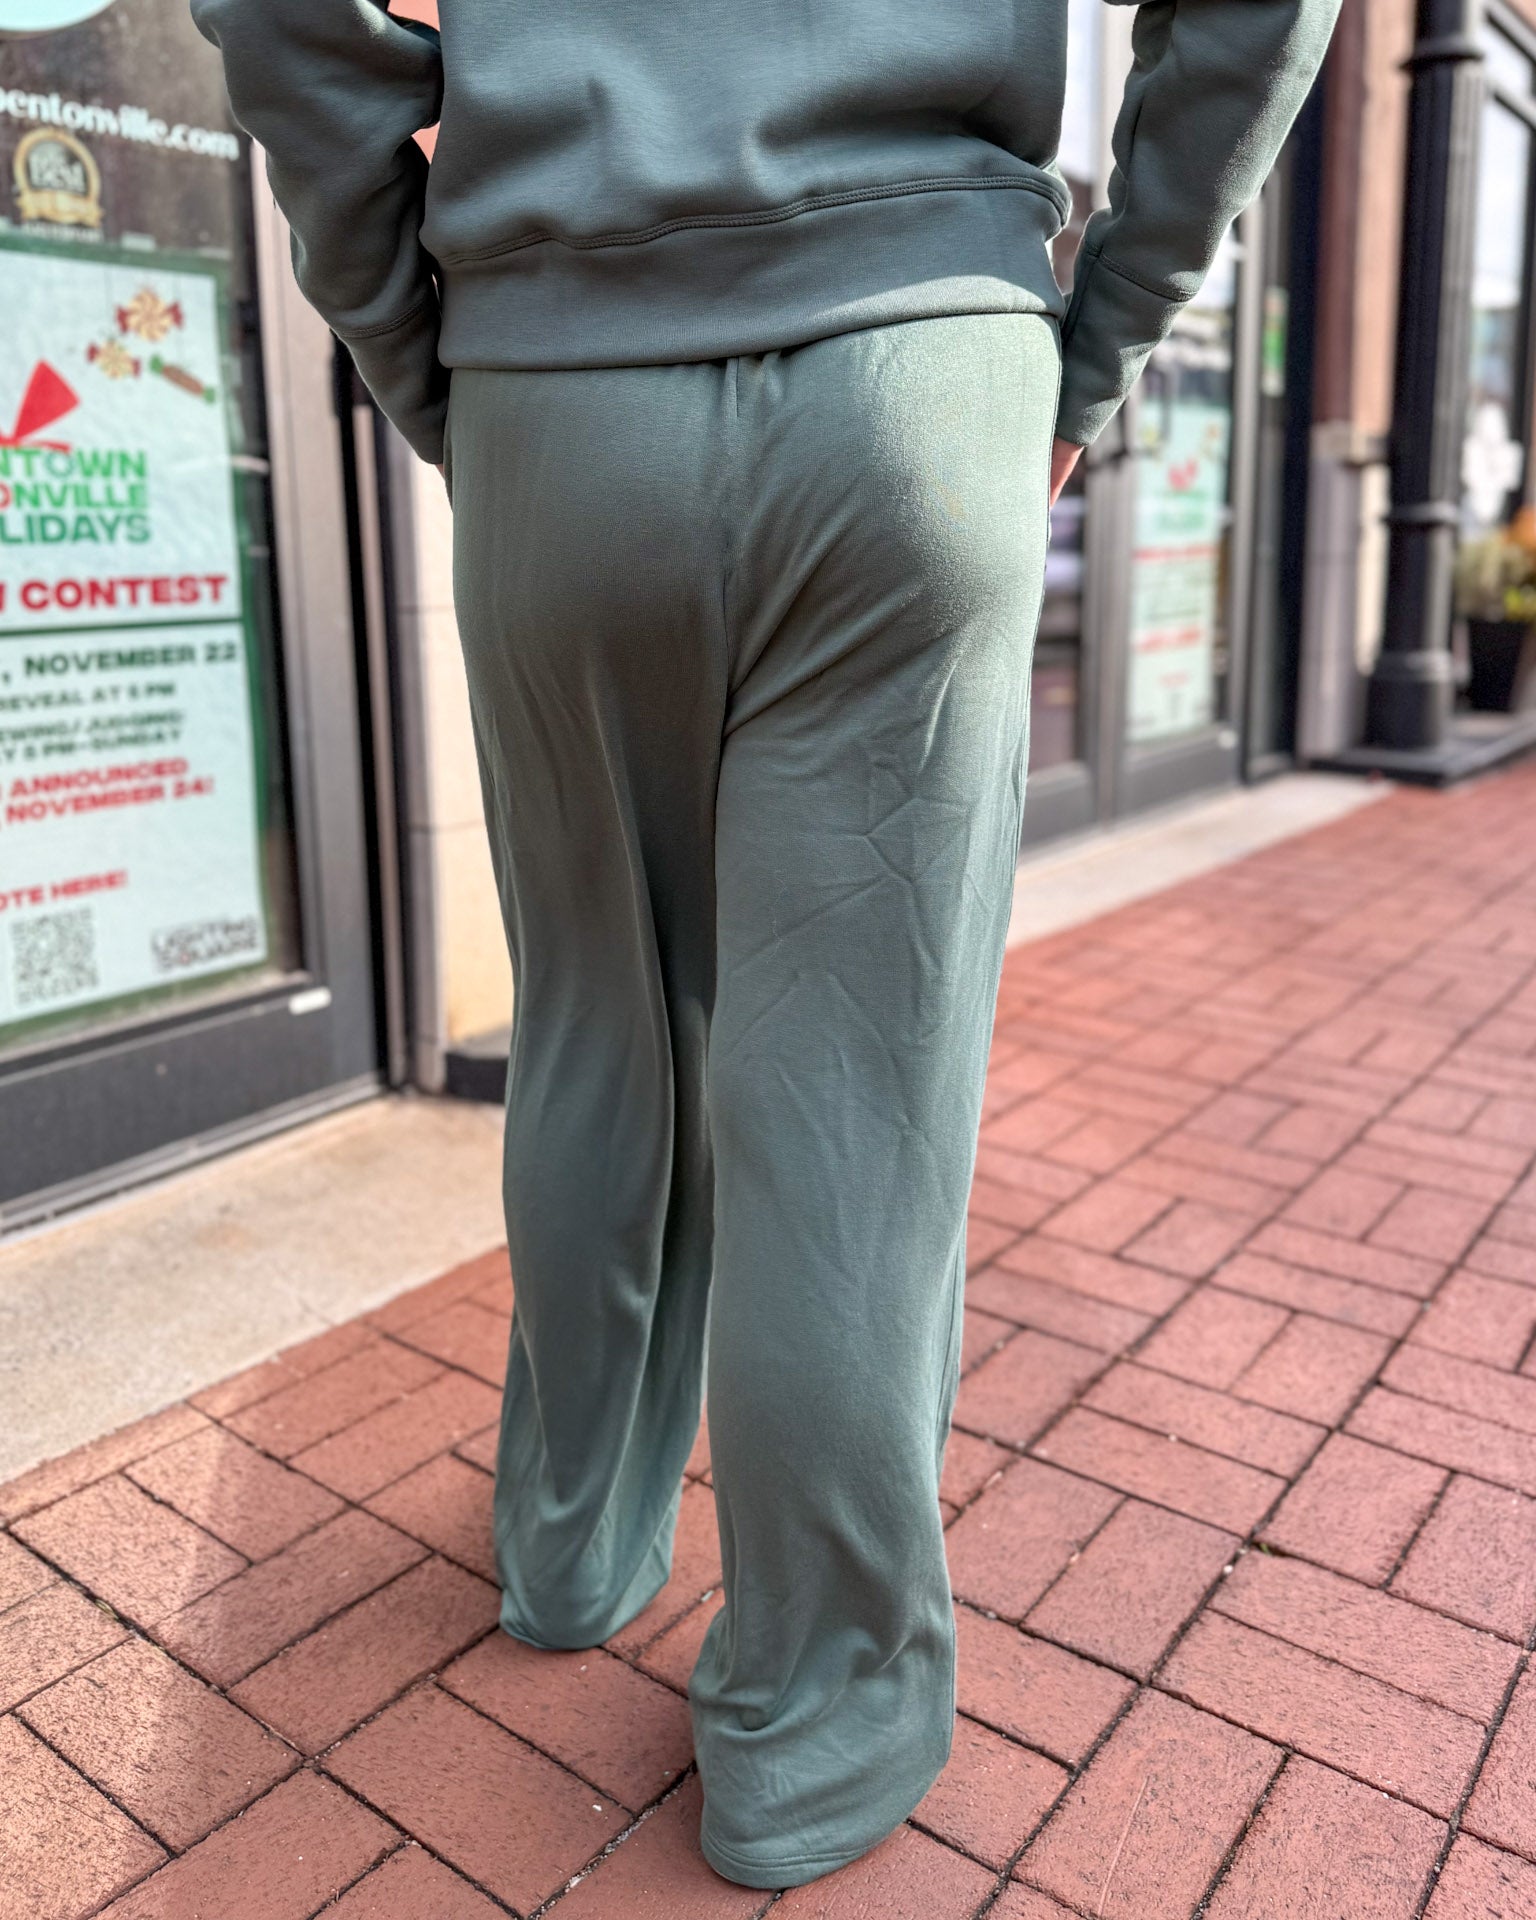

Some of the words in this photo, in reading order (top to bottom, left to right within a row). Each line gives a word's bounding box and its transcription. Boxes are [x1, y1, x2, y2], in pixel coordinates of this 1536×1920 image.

[21, 576, 227, 610] CONTEST
[25, 648, 195, 677] NOVEMBER
[10, 759, 187, 797] ANNOUNCED
[6, 785, 163, 822] NOVEMBER
